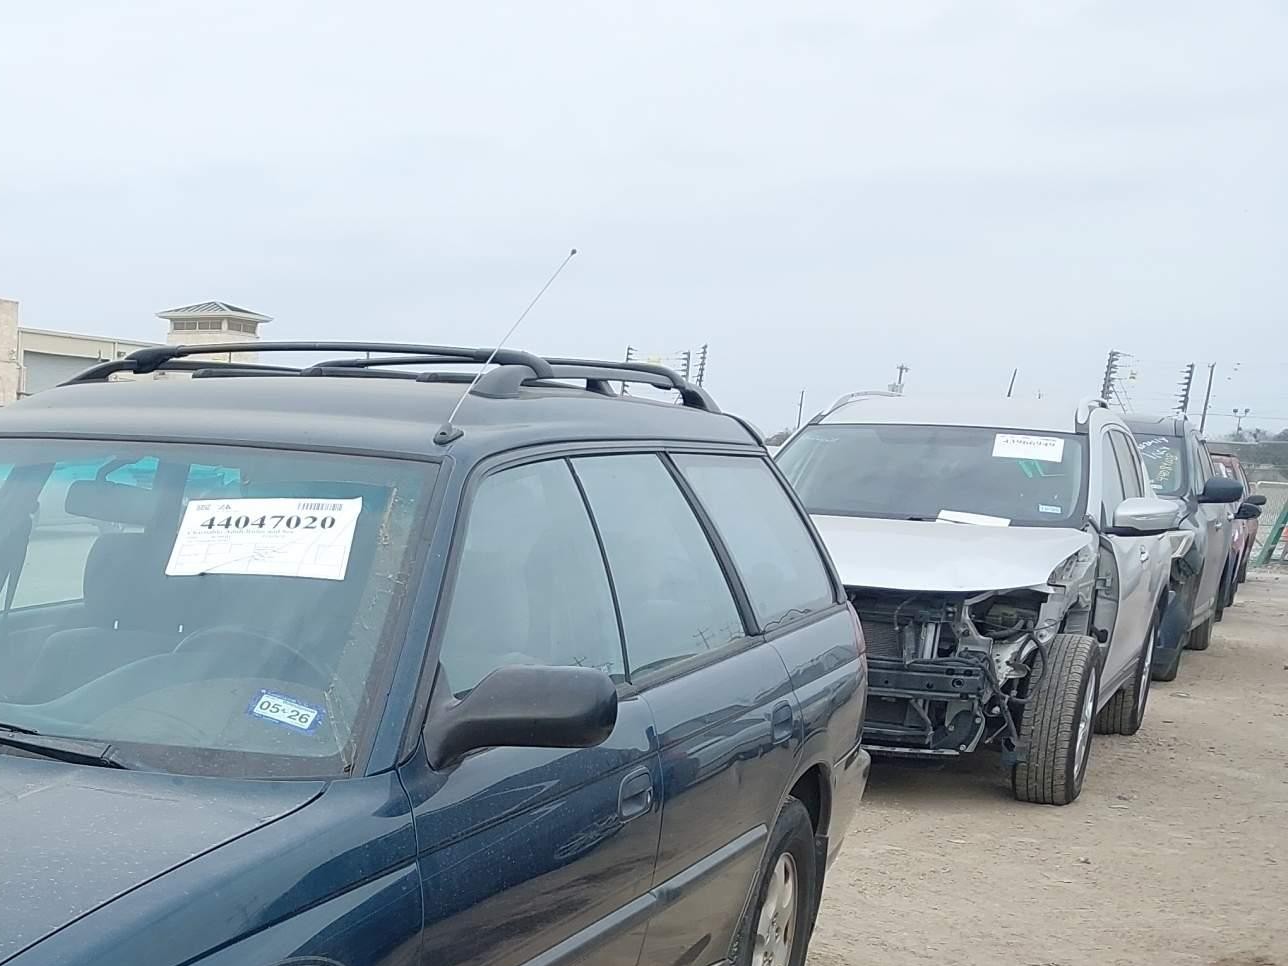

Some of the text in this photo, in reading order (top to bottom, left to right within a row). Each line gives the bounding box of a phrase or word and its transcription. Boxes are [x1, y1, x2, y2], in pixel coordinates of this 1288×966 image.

[199, 515, 337, 530] 44047020
[259, 700, 310, 724] 05 26
